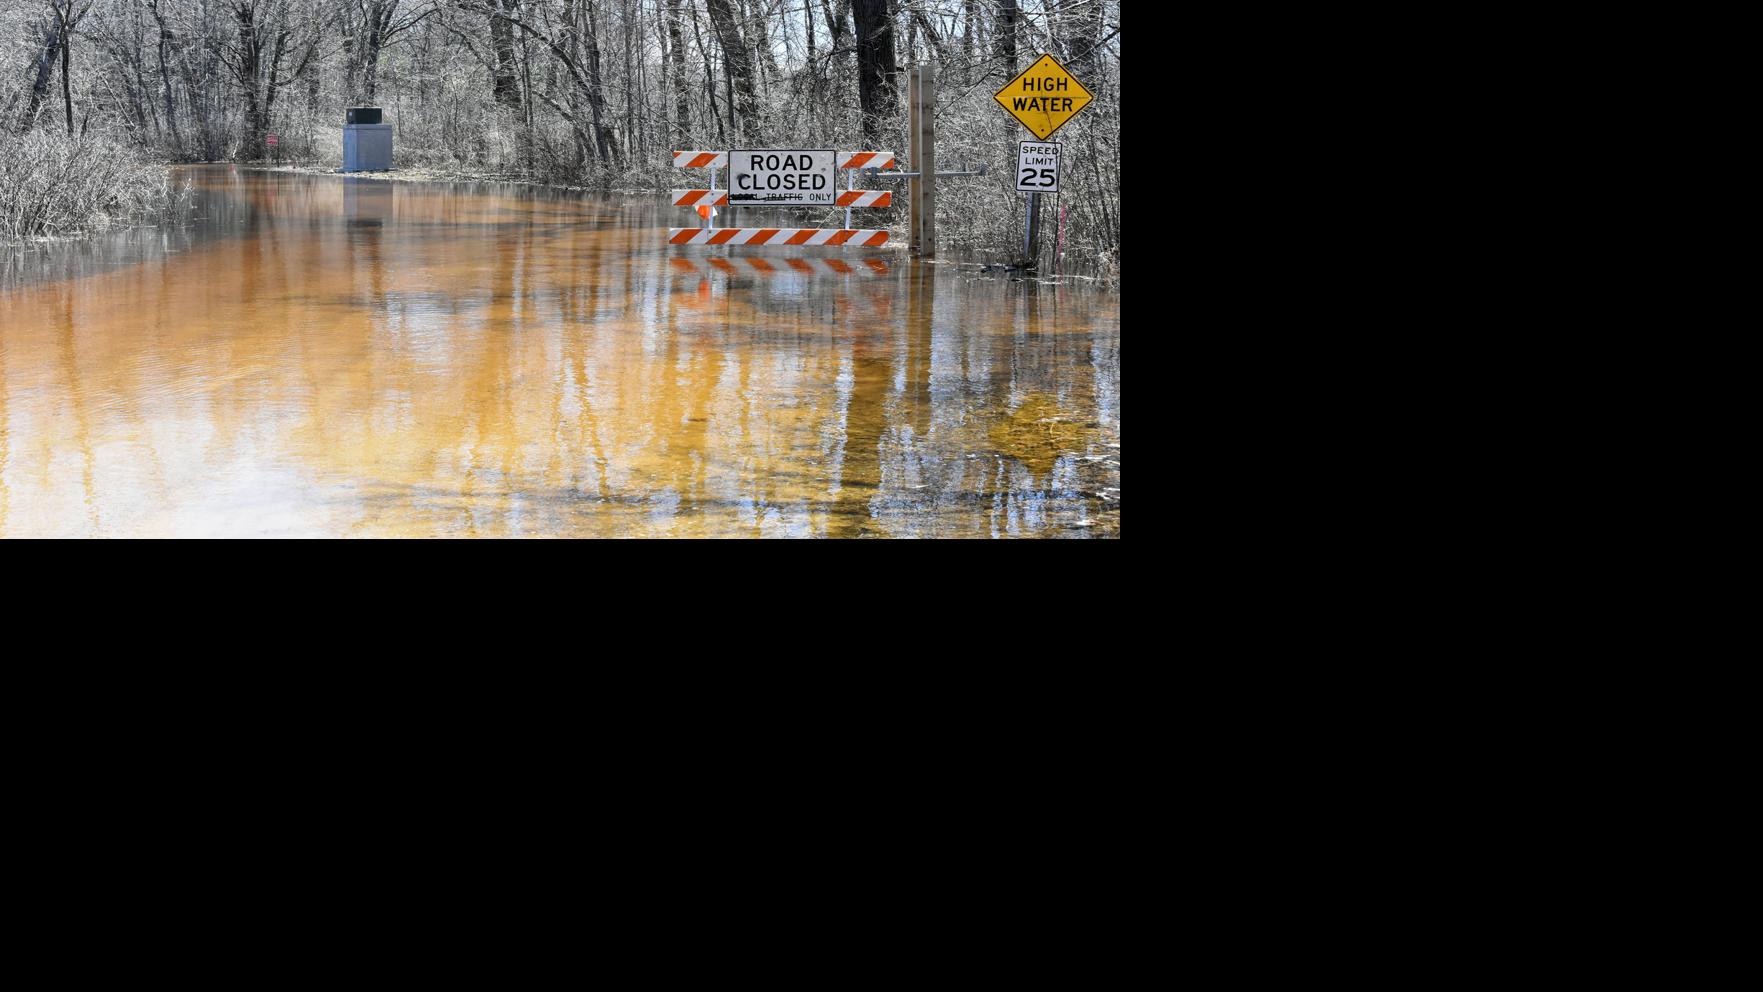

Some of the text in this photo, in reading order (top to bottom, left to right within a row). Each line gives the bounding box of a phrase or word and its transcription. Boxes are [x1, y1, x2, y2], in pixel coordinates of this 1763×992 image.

[1022, 77, 1068, 92] HIGH
[1012, 97, 1073, 112] WATER
[1022, 146, 1059, 155] SPEED
[750, 154, 813, 171] ROAD
[1025, 157, 1054, 166] LIMIT
[738, 173, 826, 190] CLOSED
[1020, 168, 1056, 187] 25
[809, 193, 832, 201] ONLY
